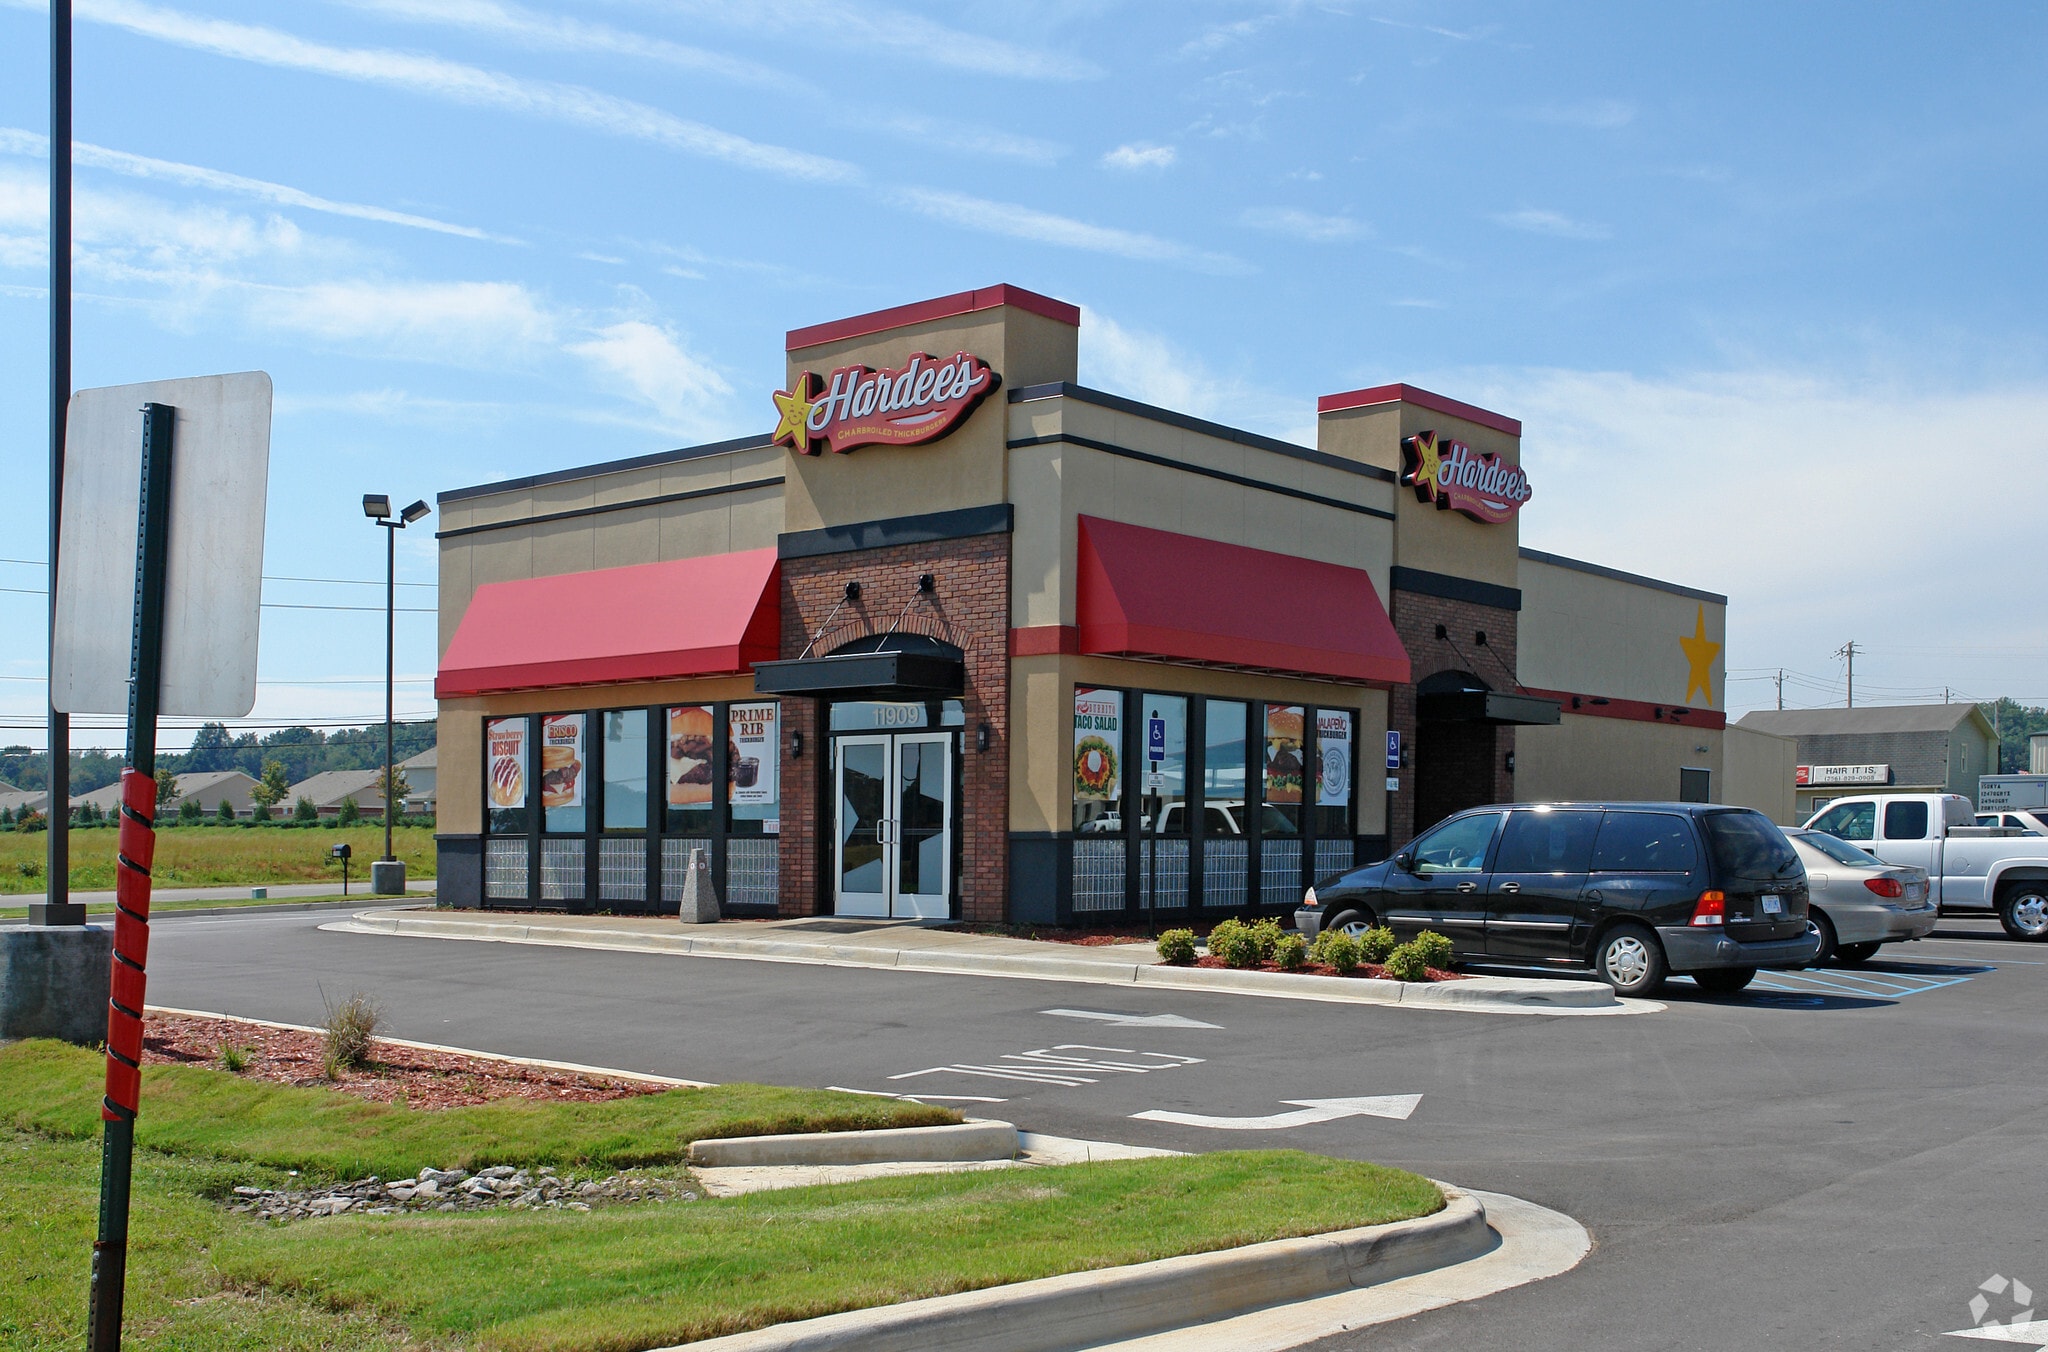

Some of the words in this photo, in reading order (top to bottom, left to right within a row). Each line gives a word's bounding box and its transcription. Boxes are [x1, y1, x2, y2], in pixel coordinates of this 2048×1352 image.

[807, 354, 984, 432] Hardee's
[837, 426, 893, 440] CHARBROILED
[893, 416, 947, 438] THICKBURGERS
[1437, 444, 1531, 502] Hardee's
[730, 708, 774, 723] PRIME
[872, 705, 920, 726] 11909
[1074, 715, 1093, 730] TACO
[1094, 716, 1118, 731] SALAD
[488, 729, 524, 744] Strawberry
[547, 724, 578, 739] FRISCO
[739, 722, 765, 736] RIB
[492, 739, 519, 757] BISCUIT
[1825, 767, 1848, 775] HAIR
[1852, 766, 1861, 774] IT
